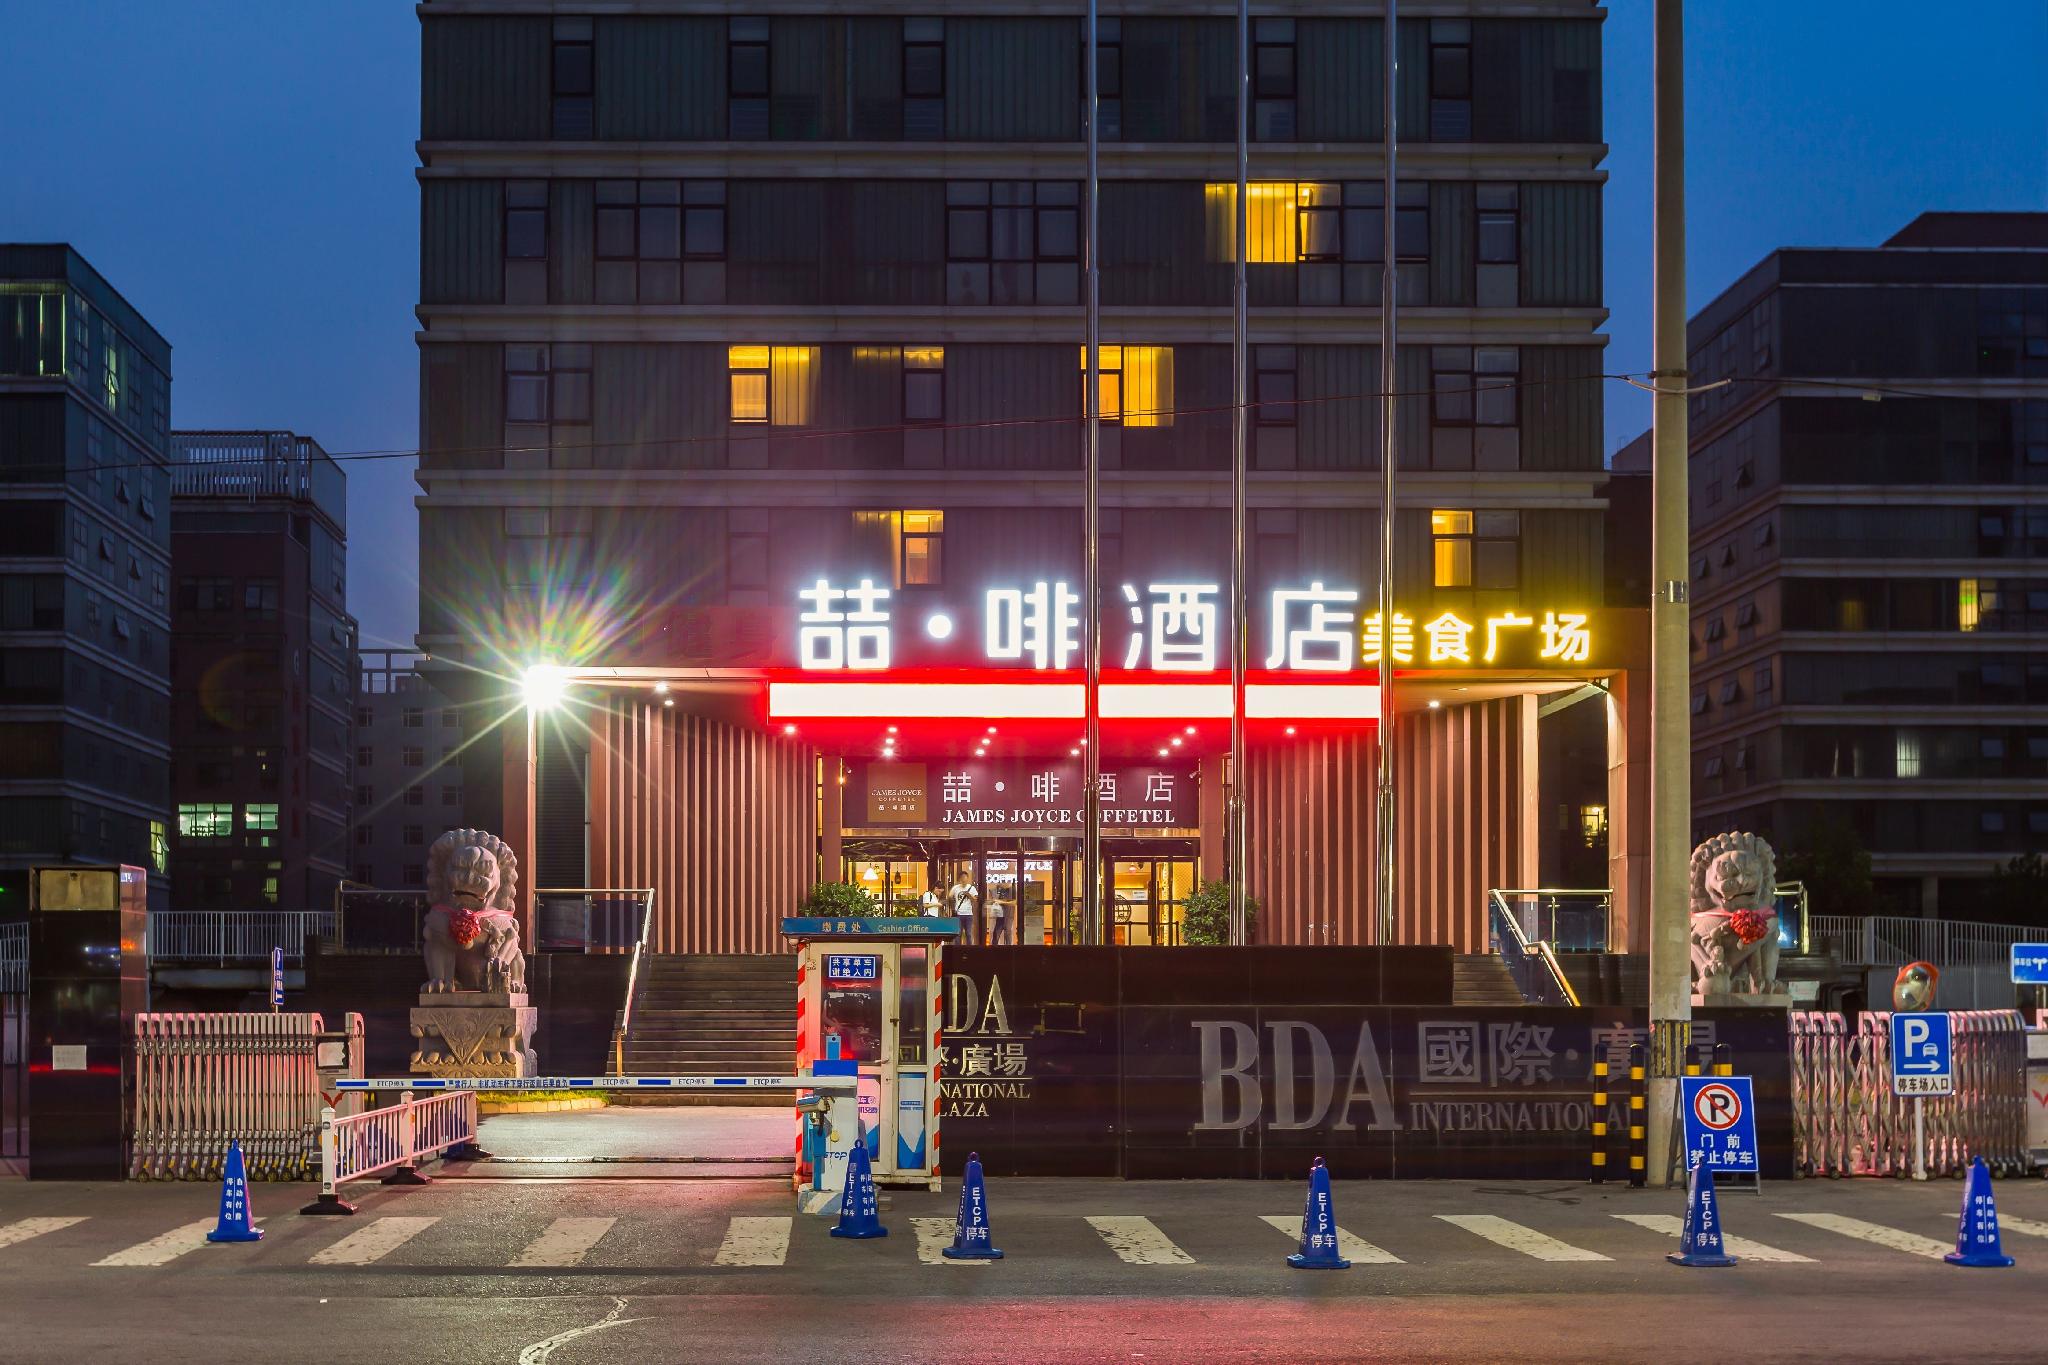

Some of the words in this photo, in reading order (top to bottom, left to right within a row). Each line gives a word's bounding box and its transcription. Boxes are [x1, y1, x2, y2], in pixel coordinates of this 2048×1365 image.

[799, 580, 1358, 670] 喆·啡酒店
[1362, 612, 1591, 662] 美食广场
[942, 809, 1005, 823] JAMES
[1010, 809, 1071, 823] JOYCE
[1075, 809, 1175, 823] CFFETEL
[821, 921, 861, 933] 缴费处
[878, 924, 905, 932] Cashier
[907, 924, 929, 932] Office
[832, 957, 872, 967] 共享单车
[831, 967, 872, 977] 谢绝入内
[943, 973, 1013, 1034] DA
[1904, 1019, 1930, 1057] P
[940, 1043, 1028, 1077] ·廣場
[1191, 1020, 1403, 1131] BDA
[940, 1083, 1030, 1099] NATIONAL
[1898, 1077, 1949, 1092] 停车场入口
[939, 1102, 990, 1117] AZA
[1700, 1133, 1740, 1149] 门前
[1690, 1149, 1754, 1165] 禁止停车
[972, 1187, 982, 1226] ETCP
[1318, 1192, 1328, 1233] ETCP
[1701, 1190, 1712, 1231] ETCP
[966, 1226, 989, 1241] 停车
[1311, 1233, 1335, 1248] 停车
[1697, 1232, 1718, 1246] 停车
